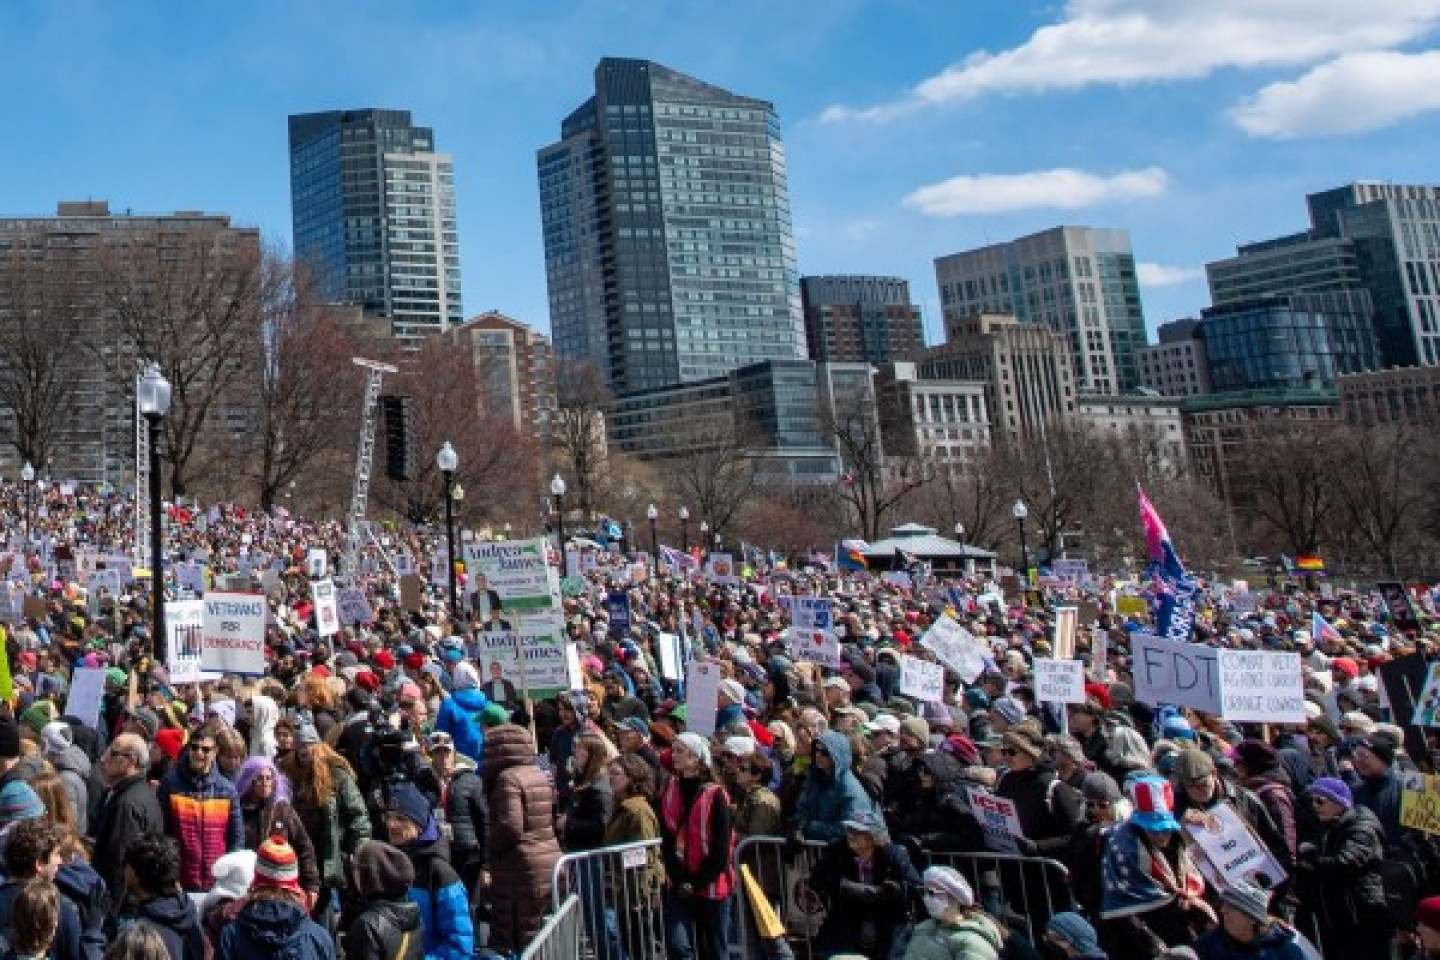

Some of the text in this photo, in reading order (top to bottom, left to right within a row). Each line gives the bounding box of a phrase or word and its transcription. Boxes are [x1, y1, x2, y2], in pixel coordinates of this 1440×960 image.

[206, 602, 262, 616] VETERANS
[220, 621, 240, 632] FOR
[204, 636, 262, 650] DEMOCRACY
[1142, 647, 1217, 697] FDT
[1221, 839, 1237, 851] NO
